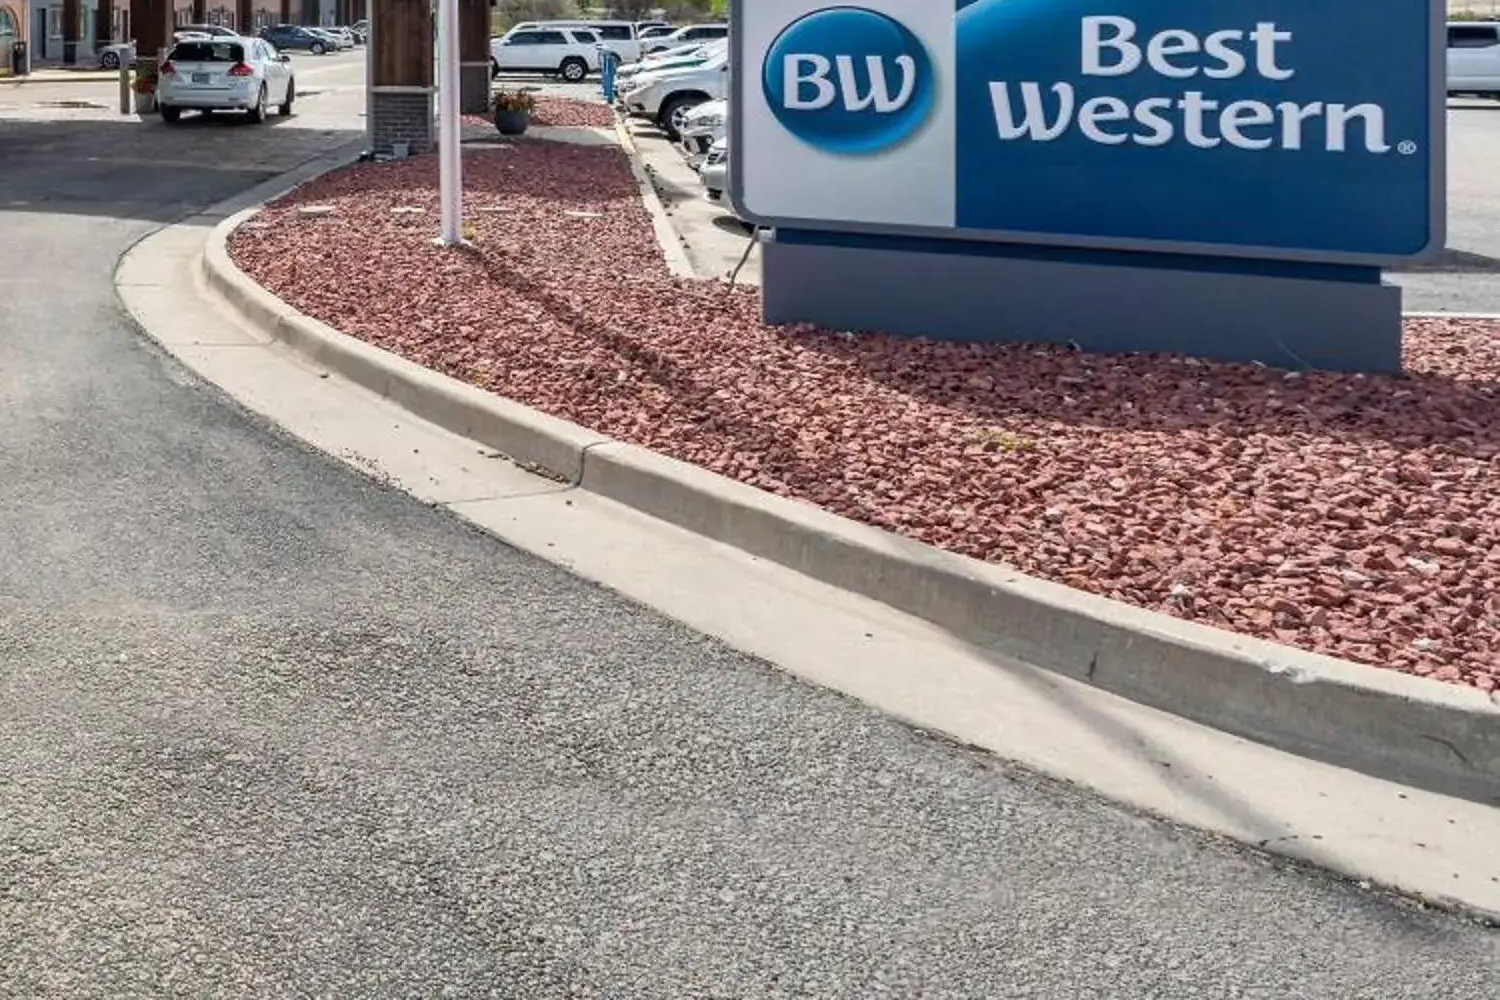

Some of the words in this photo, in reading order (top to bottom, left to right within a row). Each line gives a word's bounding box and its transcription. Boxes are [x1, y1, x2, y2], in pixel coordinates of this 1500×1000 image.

[1081, 15, 1295, 80] Best
[783, 53, 916, 113] BW
[988, 81, 1391, 153] Western
